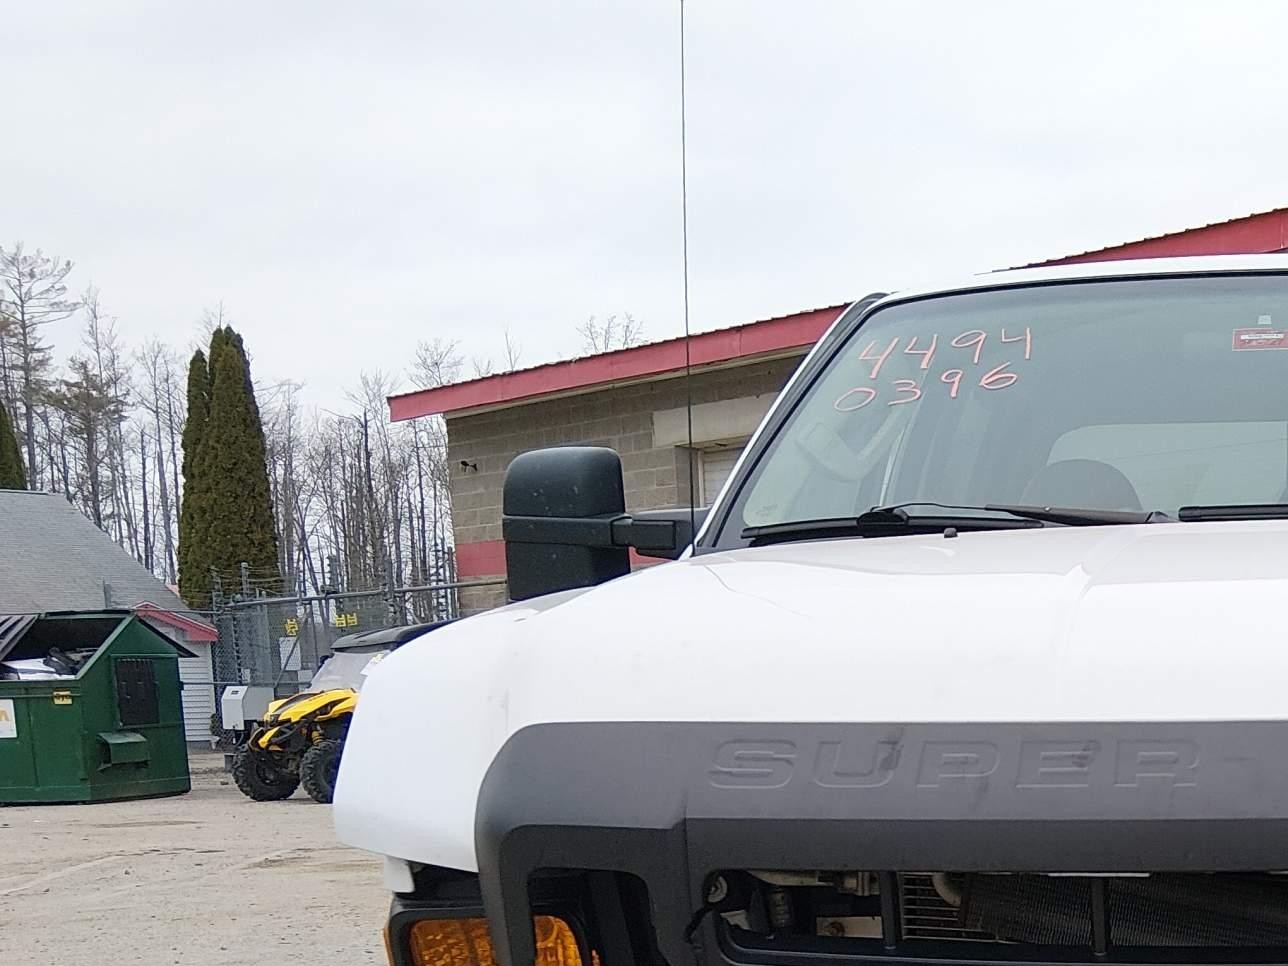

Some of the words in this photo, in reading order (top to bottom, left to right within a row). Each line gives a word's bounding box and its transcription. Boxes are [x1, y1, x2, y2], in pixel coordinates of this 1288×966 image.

[858, 327, 1031, 379] 4494
[833, 361, 1018, 412] 0396
[709, 739, 1201, 790] SUPER
